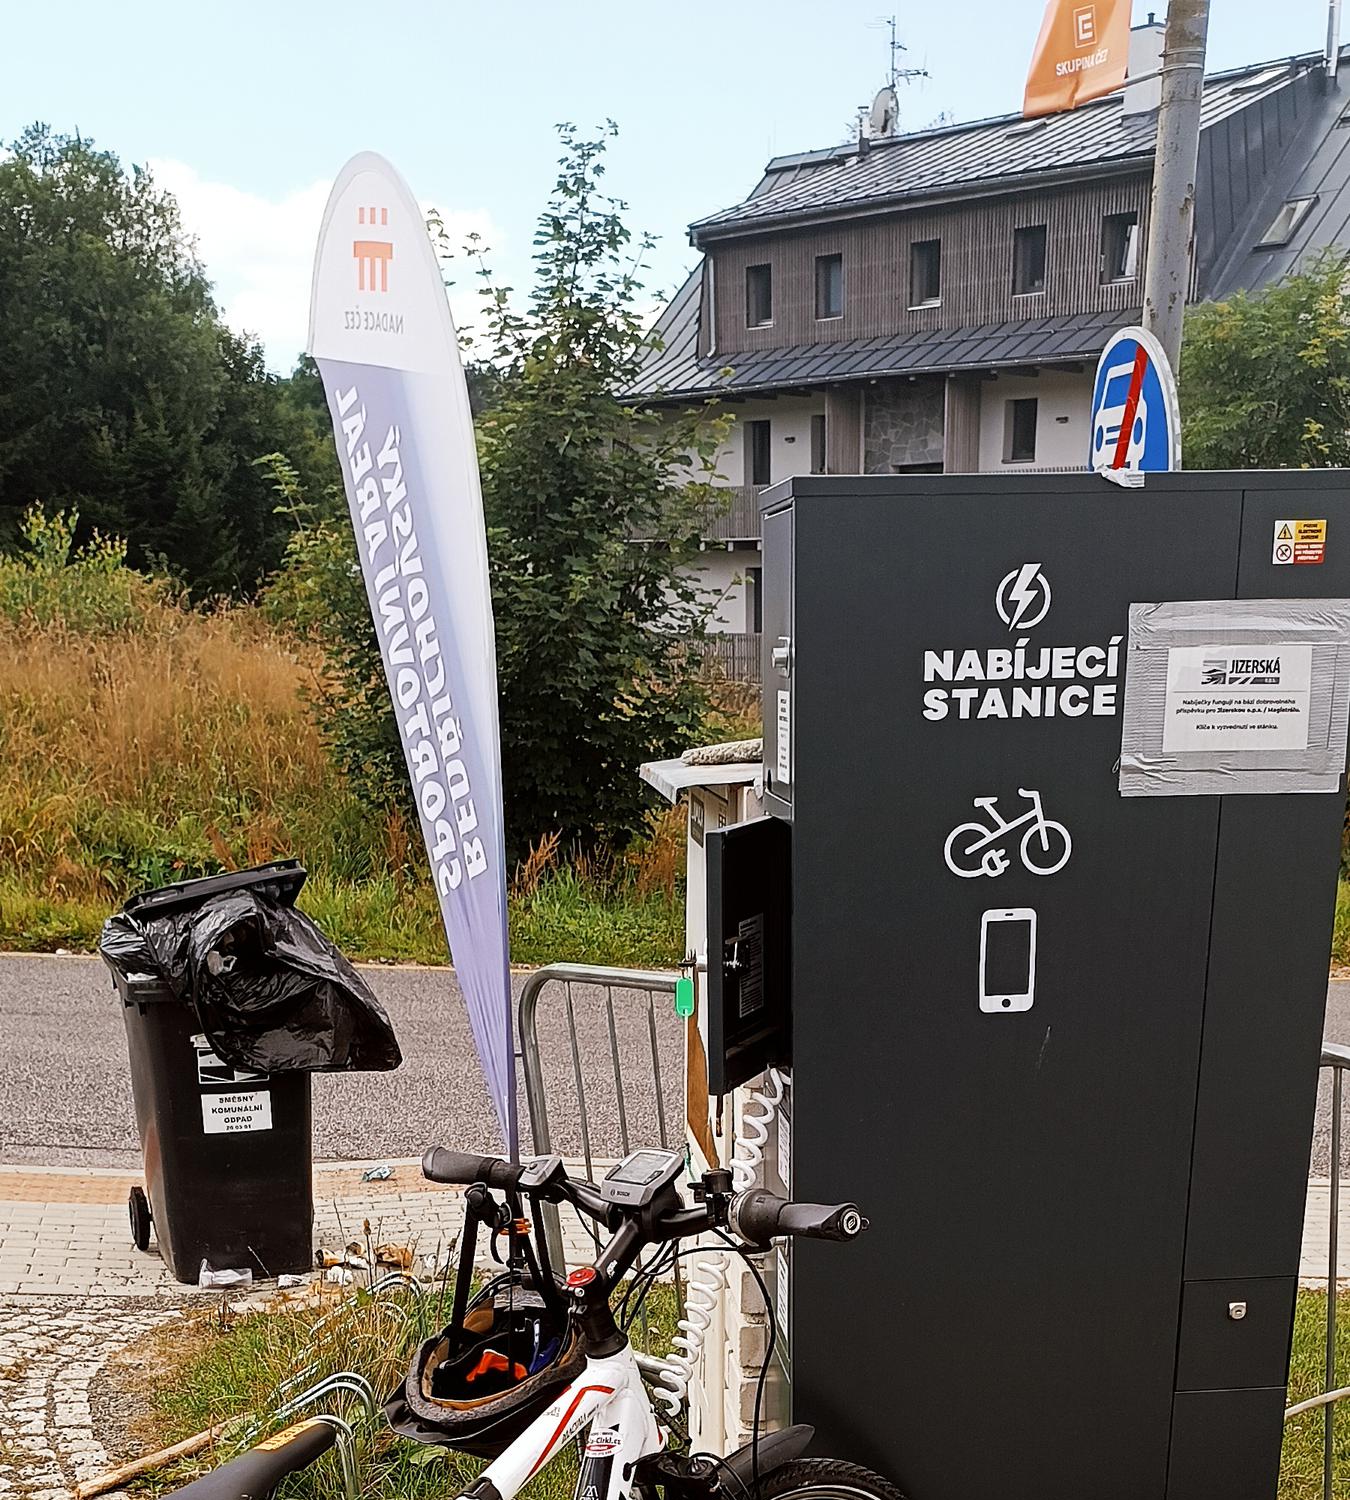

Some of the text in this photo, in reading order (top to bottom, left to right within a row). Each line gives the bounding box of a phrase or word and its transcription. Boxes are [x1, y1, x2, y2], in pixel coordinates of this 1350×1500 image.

[923, 634, 1124, 683] NABÍJECÍ
[1229, 657, 1281, 675] JIZERSKÁ
[922, 683, 1116, 721] STANICE
[223, 1115, 253, 1124] ODPAD
